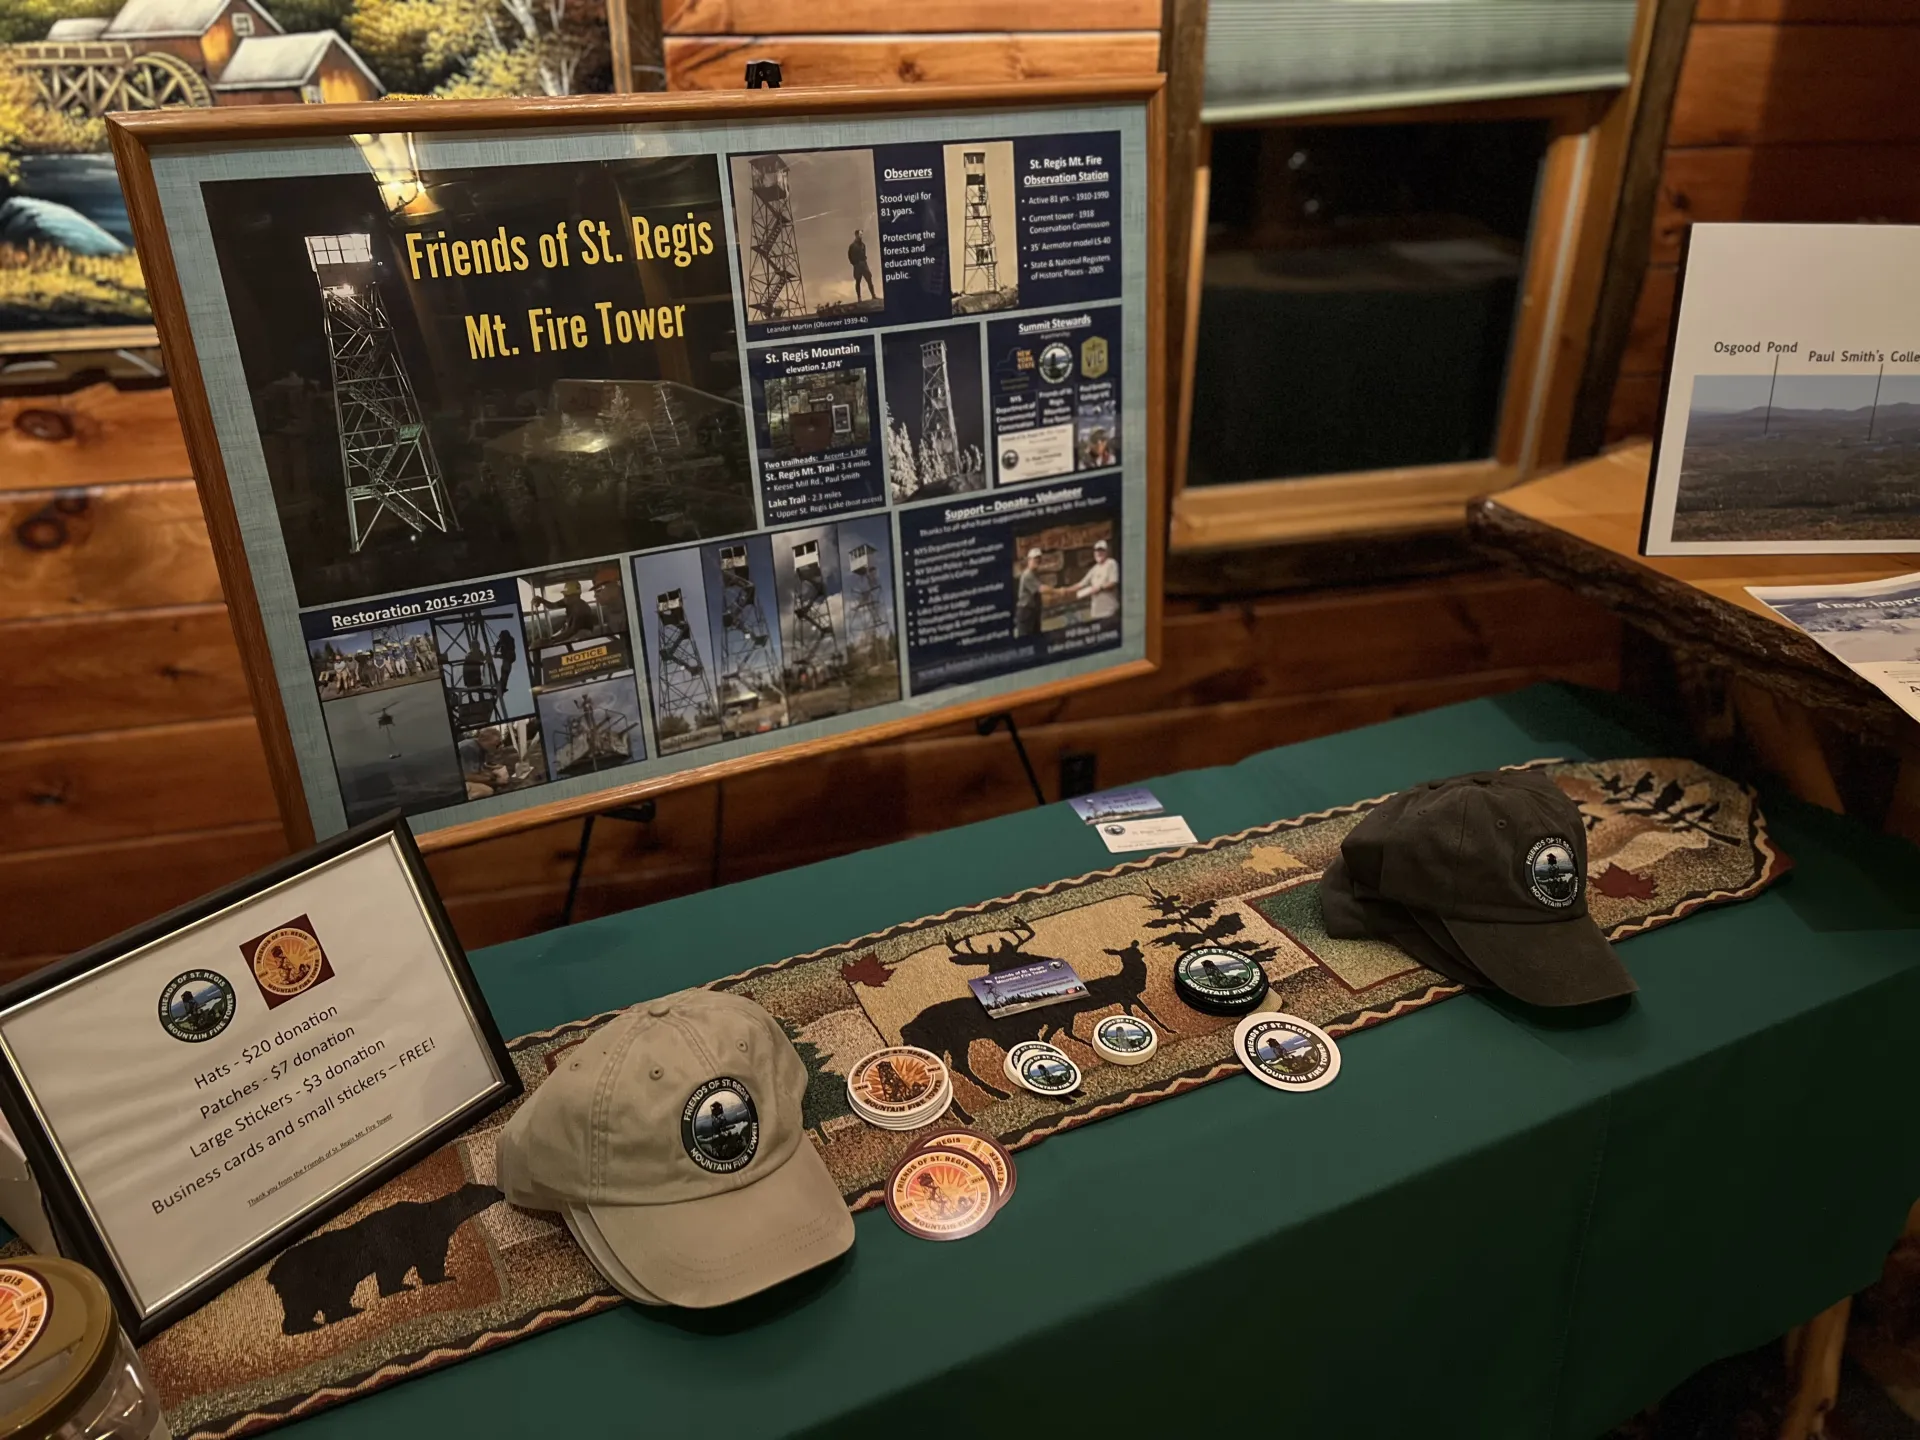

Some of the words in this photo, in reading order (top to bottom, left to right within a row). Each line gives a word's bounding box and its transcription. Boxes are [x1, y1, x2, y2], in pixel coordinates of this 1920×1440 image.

[1030, 159, 1042, 169] St.
[1044, 157, 1067, 170] Regis
[1068, 156, 1084, 166] Mt.
[1086, 154, 1102, 165] Fire
[884, 168, 932, 180] Observers
[1024, 172, 1076, 186] Observation
[1078, 170, 1108, 182] Station
[880, 193, 902, 204] Stood
[904, 192, 919, 203] vigil
[920, 192, 931, 200] for
[1028, 196, 1048, 204] Active
[1076, 191, 1109, 200] 1910-1990
[881, 208, 890, 216] 81
[1029, 214, 1054, 222] Current
[1055, 213, 1074, 221] tower
[1079, 210, 1094, 218] 1918
[882, 232, 922, 242] Protecting
[922, 230, 936, 239] the
[1030, 224, 1071, 234] Conservation
[1072, 221, 1110, 230] Commission
[405, 226, 529, 280] Friends
[538, 222, 570, 268] of
[578, 219, 623, 265] St.
[632, 212, 714, 267] Regis
[884, 246, 910, 256] forests
[911, 244, 926, 252] and
[1042, 240, 1072, 250] Aermotor
[1073, 238, 1093, 247] model
[1094, 236, 1111, 246] LS-40
[884, 258, 922, 268] educating
[922, 256, 936, 264] the
[1030, 260, 1046, 270] State
[1056, 256, 1080, 266] National
[1082, 254, 1110, 264] Registers
[886, 272, 911, 282] public.
[1031, 272, 1038, 280] of
[1039, 271, 1062, 279] Historic
[1064, 268, 1083, 276] Places
[465, 314, 520, 360] Mt.
[528, 306, 588, 353] Fire
[595, 301, 686, 346] Tower
[766, 326, 791, 334] Leander
[792, 322, 812, 330] Martin
[814, 320, 842, 330] (Observer
[844, 316, 868, 325] 1939-42)
[1018, 320, 1050, 334] Summit
[1052, 314, 1092, 329] Stewards
[766, 354, 780, 364] St.
[782, 349, 809, 362] Regis
[812, 343, 860, 358] Mountain
[1714, 341, 1760, 356] Osgood
[1767, 341, 1798, 352] Pond
[1808, 351, 1834, 362] Paul
[1841, 350, 1884, 362] Smith's
[786, 364, 820, 374] elevation
[764, 462, 780, 470] Two
[782, 456, 818, 466] trailheads:
[766, 473, 777, 482] St.
[778, 470, 800, 480] Regis
[802, 467, 816, 476] Mt.
[818, 463, 835, 474] Trail
[854, 460, 871, 468] miles
[774, 482, 794, 492] Keese
[796, 478, 809, 488] Mill
[825, 475, 840, 484] Paul
[840, 472, 860, 481] Smith
[768, 498, 788, 508] Lake
[788, 494, 806, 506] Trail
[824, 490, 842, 499] miles
[776, 510, 798, 518] Upper
[800, 506, 808, 515] St.
[810, 504, 827, 514] Regis
[829, 500, 844, 510] Lake
[944, 506, 984, 521] Support
[994, 496, 1030, 512] Donate
[332, 603, 421, 629] Restoration
[424, 589, 495, 612] 2015-2023
[566, 648, 603, 664] NOTICE
[1526, 840, 1546, 865] FRIENDS
[1531, 886, 1562, 908] MOUNTAIN
[1226, 950, 1251, 964] REGIS
[162, 982, 178, 1016] FRIENDS
[178, 973, 188, 984] OF
[204, 972, 226, 988] REGIS
[1185, 980, 1230, 996] MOUNTAIN
[1233, 986, 1252, 994] FIRE
[168, 1023, 207, 1040] MOUNTAIN
[209, 1022, 226, 1036] FIRE
[224, 993, 232, 1020] TOWER
[194, 1065, 231, 1090] Hats
[242, 1039, 272, 1064] $20
[274, 1004, 338, 1046] donation
[1248, 1029, 1259, 1056] FRIENDS
[1258, 1022, 1268, 1030] OF
[1286, 1024, 1312, 1038] REGIS
[1260, 1064, 1306, 1082] MOUNTAIN
[1308, 1066, 1324, 1079] FIRE
[1317, 1042, 1328, 1066] TOWER
[200, 1082, 260, 1120] Patches
[270, 1060, 289, 1081] $7
[293, 1026, 356, 1068] donation
[190, 1128, 234, 1158] Large
[235, 1094, 293, 1132] Stickers
[302, 1072, 322, 1094] $3
[326, 1038, 386, 1080] donation
[684, 1086, 708, 1121] FRIENDS
[708, 1080, 720, 1090] OF
[732, 1081, 750, 1102] REGIS
[864, 1098, 905, 1112] MOUNTAIN
[151, 1167, 222, 1214] Business
[224, 1140, 265, 1172] cards
[267, 1122, 296, 1148] and
[297, 1096, 336, 1128] small
[337, 1068, 388, 1104] stickers
[399, 1037, 436, 1067] FREE!
[690, 1148, 732, 1170] MOUNTAIN
[747, 1122, 758, 1154] TOWER
[247, 1192, 266, 1208] Thank
[266, 1184, 278, 1196] you
[278, 1175, 293, 1188] from
[294, 1168, 303, 1179] the
[304, 1156, 326, 1173] Friends
[340, 1137, 356, 1150] Regis
[366, 1124, 376, 1134] Fire
[376, 1113, 394, 1127] Tower
[896, 1164, 916, 1193] FRIENDS
[918, 1156, 928, 1166] OF
[945, 1156, 969, 1169] REGIS
[913, 1217, 956, 1230] MOUNTAIN
[11, 1315, 40, 1351] TOWER
